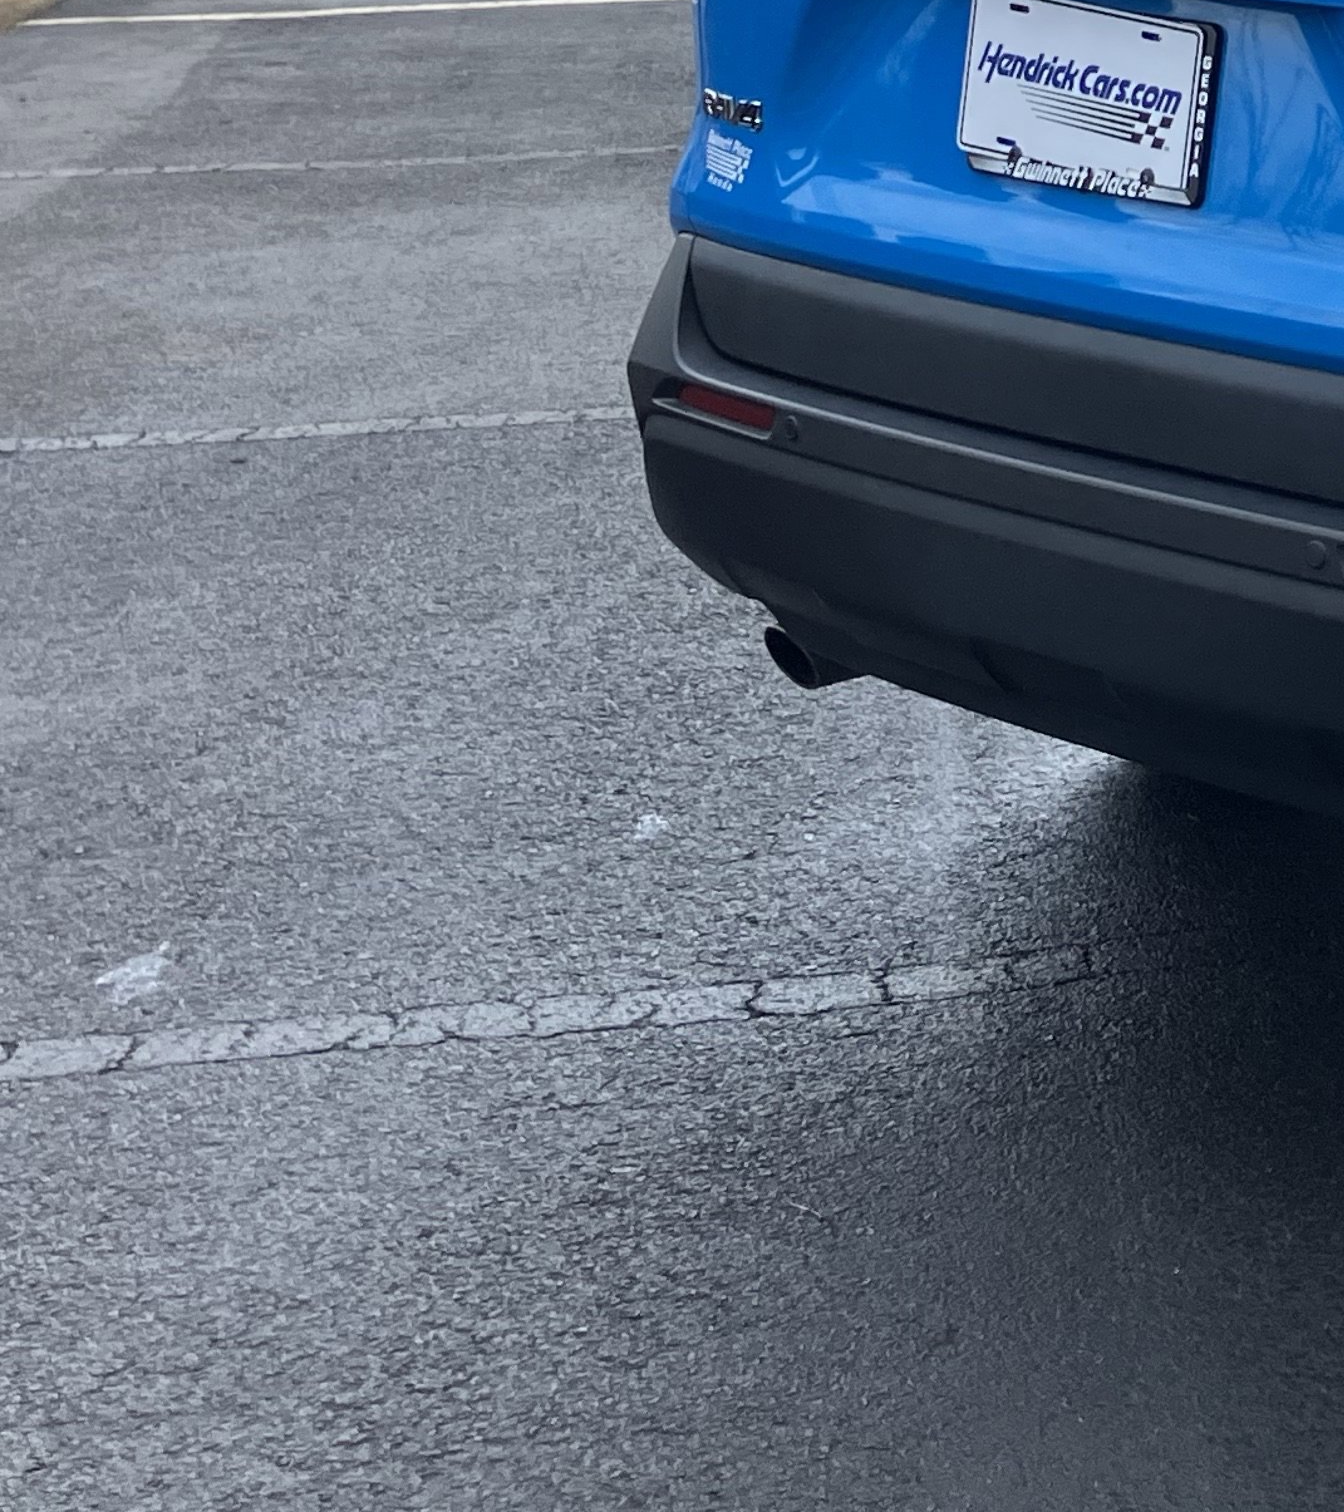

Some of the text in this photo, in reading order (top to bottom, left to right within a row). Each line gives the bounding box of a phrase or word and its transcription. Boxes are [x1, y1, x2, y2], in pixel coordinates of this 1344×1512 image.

[1190, 56, 1213, 178] GEORGIA
[1013, 156, 1142, 198] Gwinnett Place
